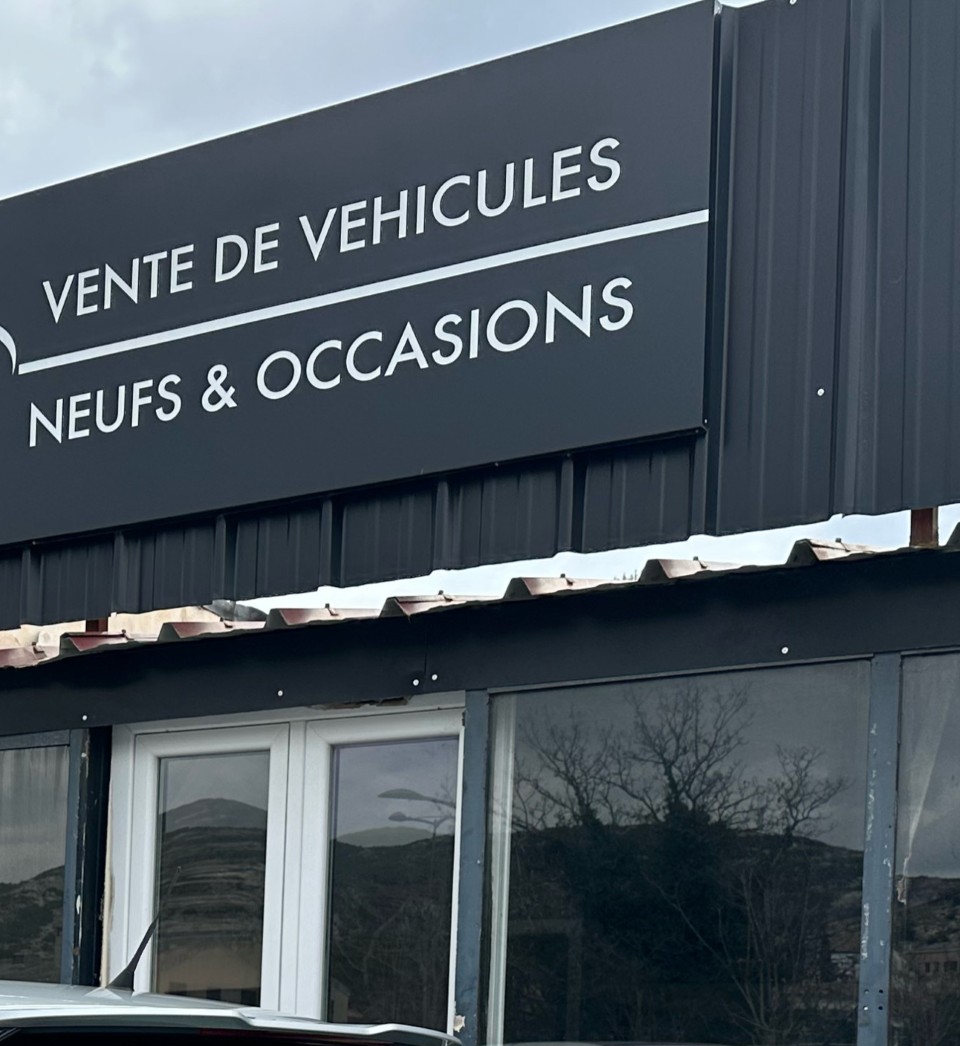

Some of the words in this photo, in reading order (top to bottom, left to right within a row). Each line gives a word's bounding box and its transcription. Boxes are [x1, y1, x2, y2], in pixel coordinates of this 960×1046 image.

[42, 243, 195, 324] VENTE
[214, 222, 280, 284] DE
[298, 137, 621, 262] VEHICULES
[29, 373, 182, 448] NEUFS
[201, 363, 238, 413] &
[256, 276, 634, 400] OCCASIONS
